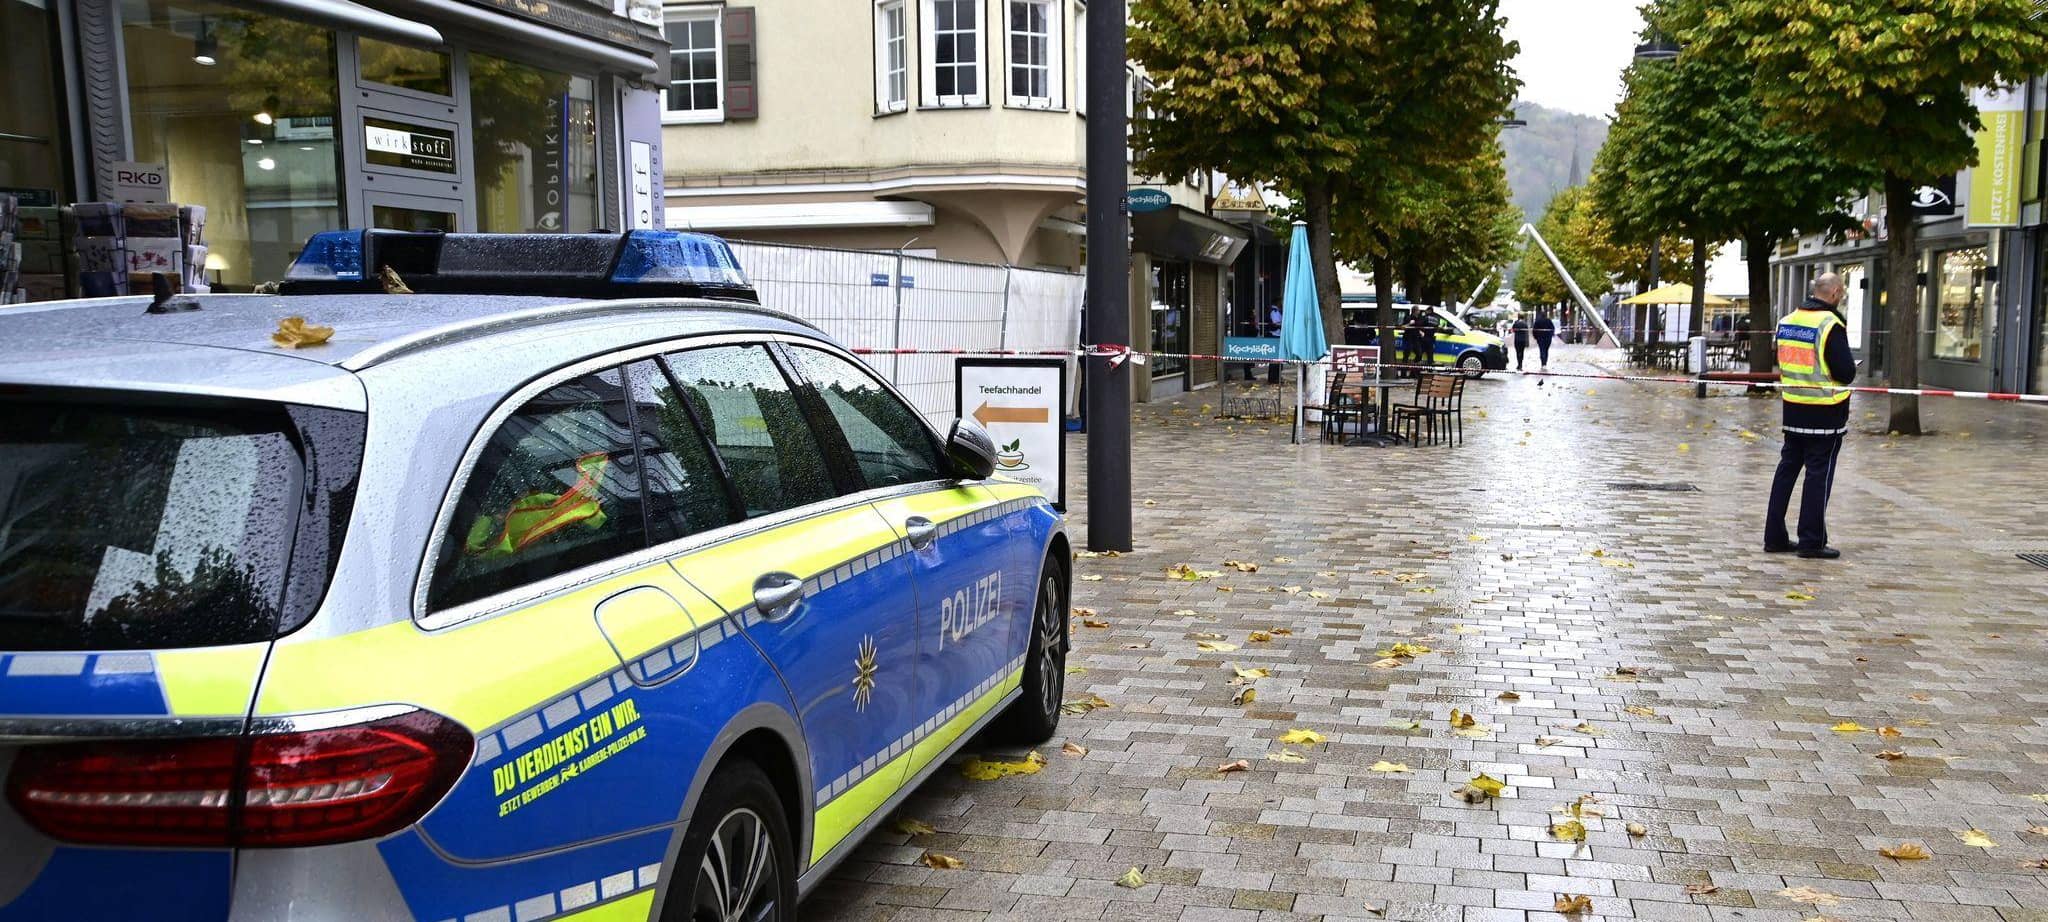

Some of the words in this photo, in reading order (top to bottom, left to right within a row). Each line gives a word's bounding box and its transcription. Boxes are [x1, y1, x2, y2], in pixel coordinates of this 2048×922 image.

[117, 170, 162, 185] RKD
[1228, 343, 1276, 356] Kochlöffel
[979, 385, 1042, 395] Teefachhandel
[939, 570, 1001, 651] POLIZEI
[493, 761, 516, 797] DU
[516, 723, 589, 783] VERDIENST
[589, 711, 613, 744] EIN
[611, 698, 641, 731] WIR.
[499, 795, 522, 818] JETZT
